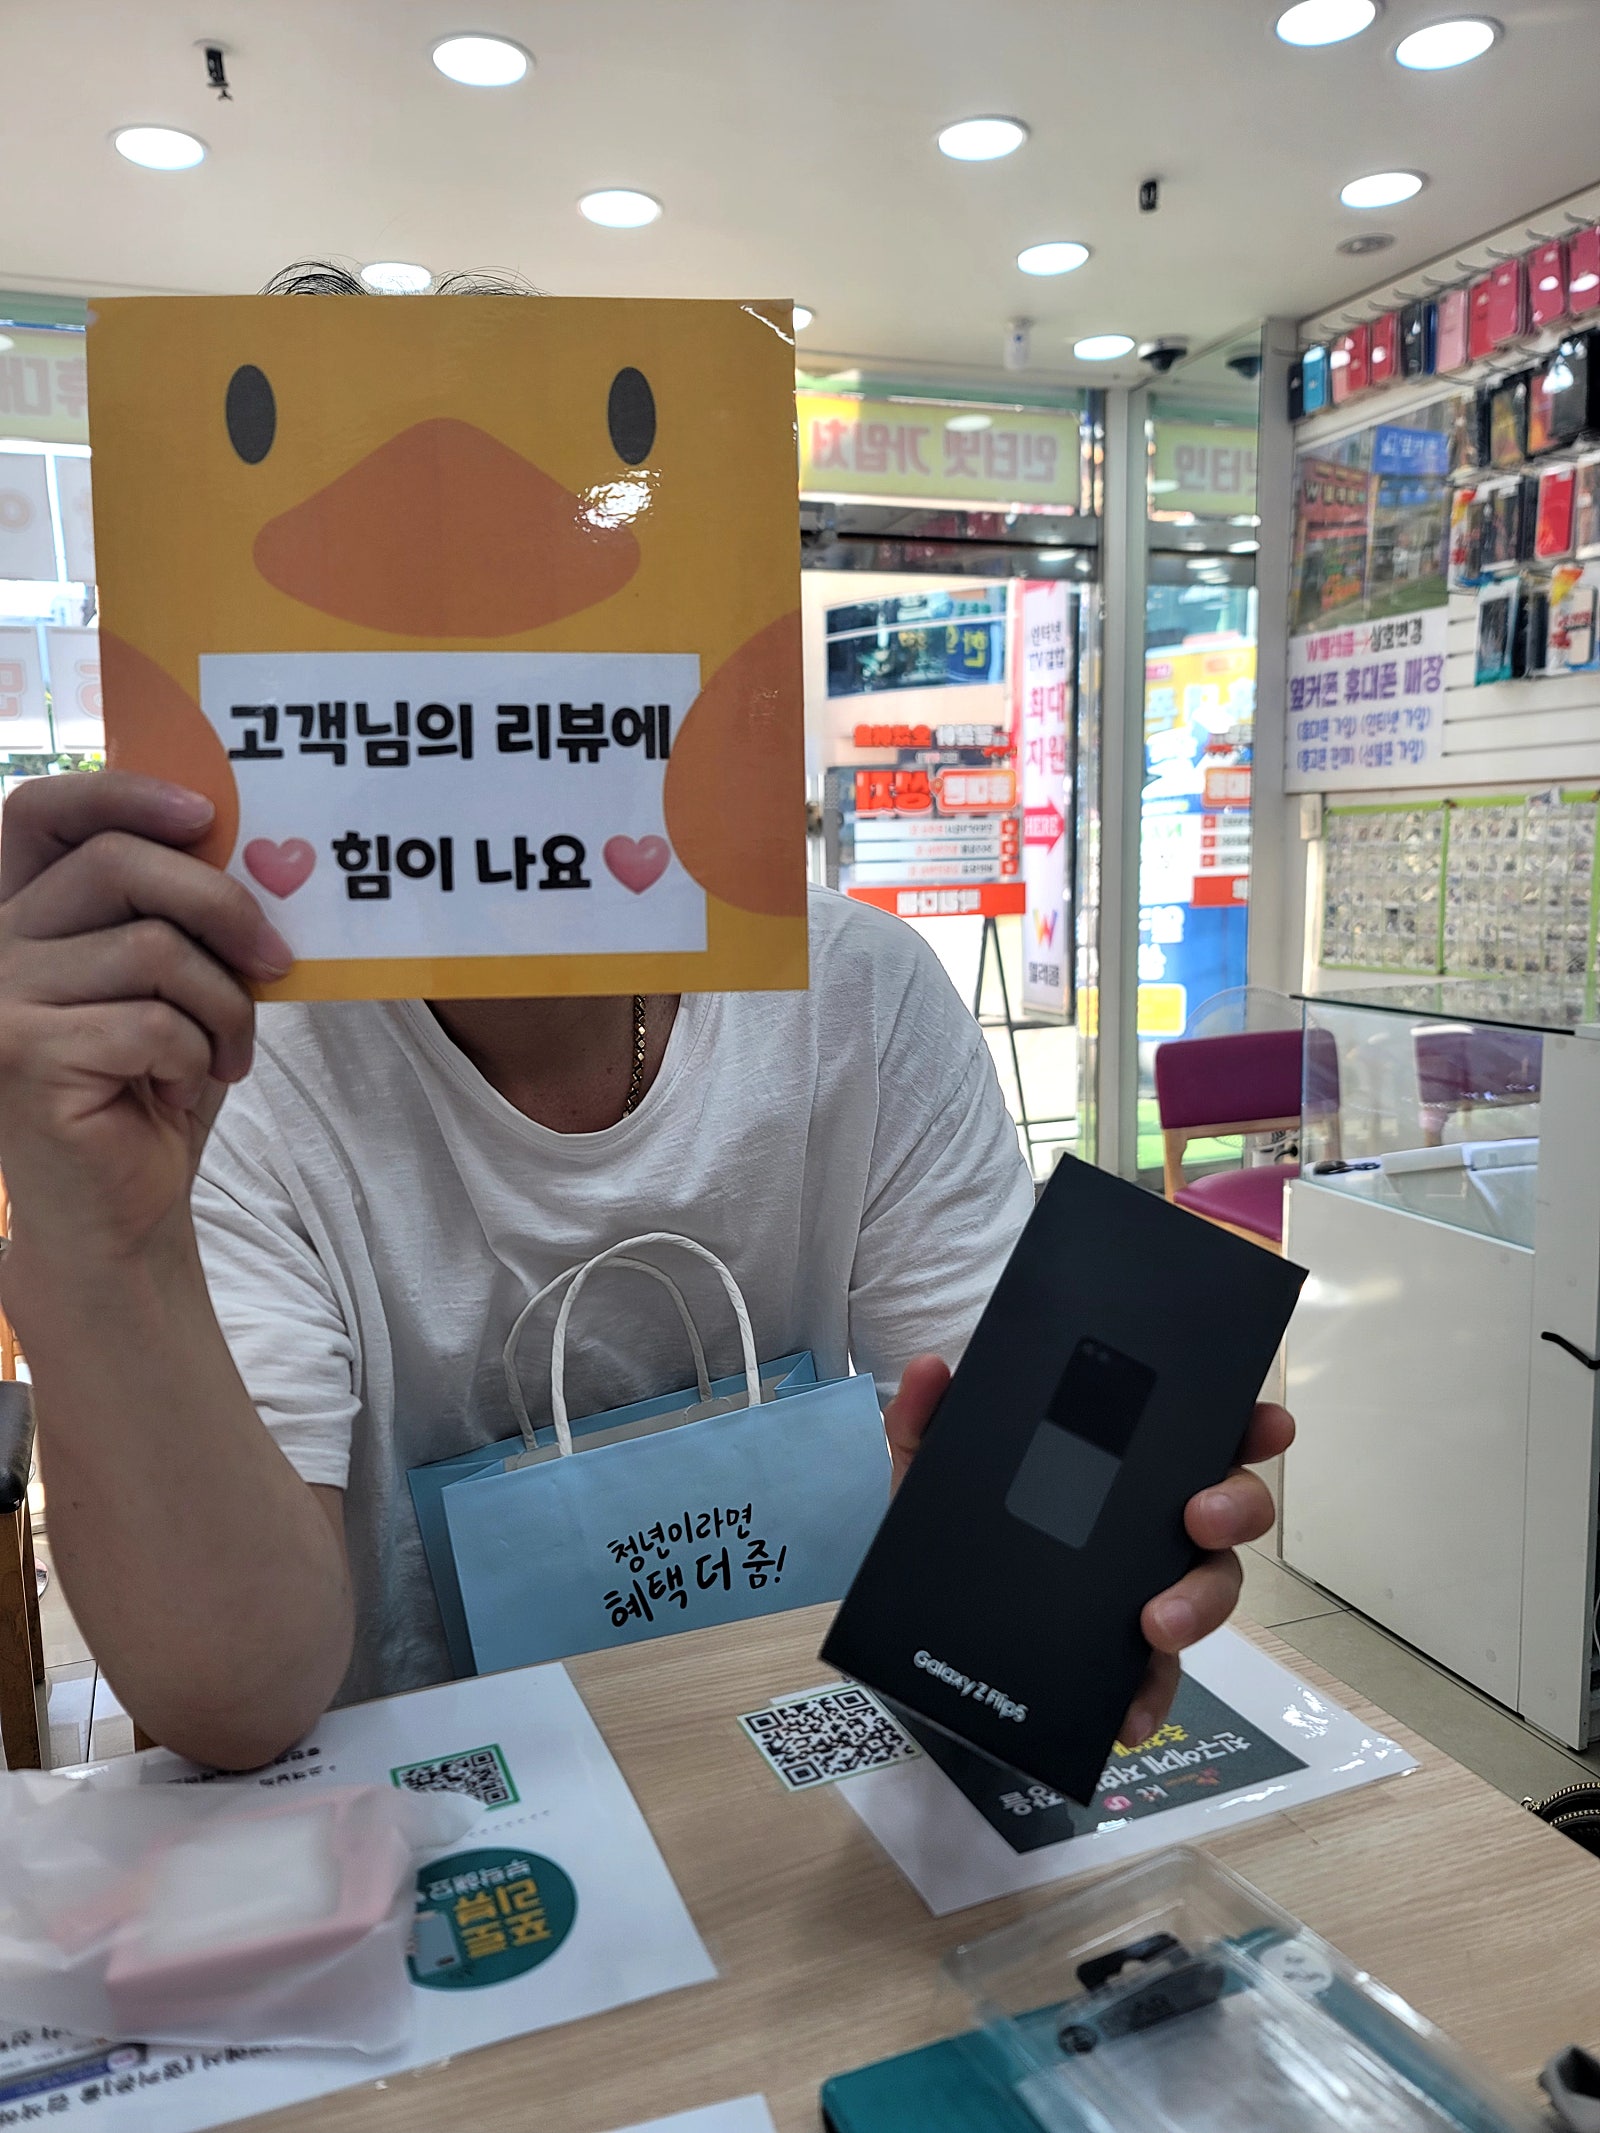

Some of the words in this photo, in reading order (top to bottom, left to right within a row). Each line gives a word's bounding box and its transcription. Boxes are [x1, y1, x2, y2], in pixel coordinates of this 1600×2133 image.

[1027, 683, 1065, 723] 최대
[1344, 662, 1397, 704] 휴대폰
[1404, 654, 1444, 694] 매장
[228, 702, 474, 767] 고객님의
[497, 703, 671, 763] 리뷰에
[1026, 736, 1065, 775] 지원
[1024, 816, 1058, 836] HERE
[332, 831, 454, 900] 힘이
[476, 835, 591, 890] 나요
[607, 1503, 752, 1573] 청년이라면
[603, 1564, 688, 1627] 혜택
[695, 1546, 731, 1591] 더
[742, 1539, 787, 1589] 줌!
[914, 1650, 977, 1697] Galaxy
[972, 1682, 990, 1701] Z
[985, 1688, 1029, 1723] Flip5
[1141, 1732, 1251, 1775] 친구에게
[1000, 1785, 1065, 1816] 장을
[453, 1878, 541, 1926] 리뷰
[461, 1908, 552, 1959] 포토
